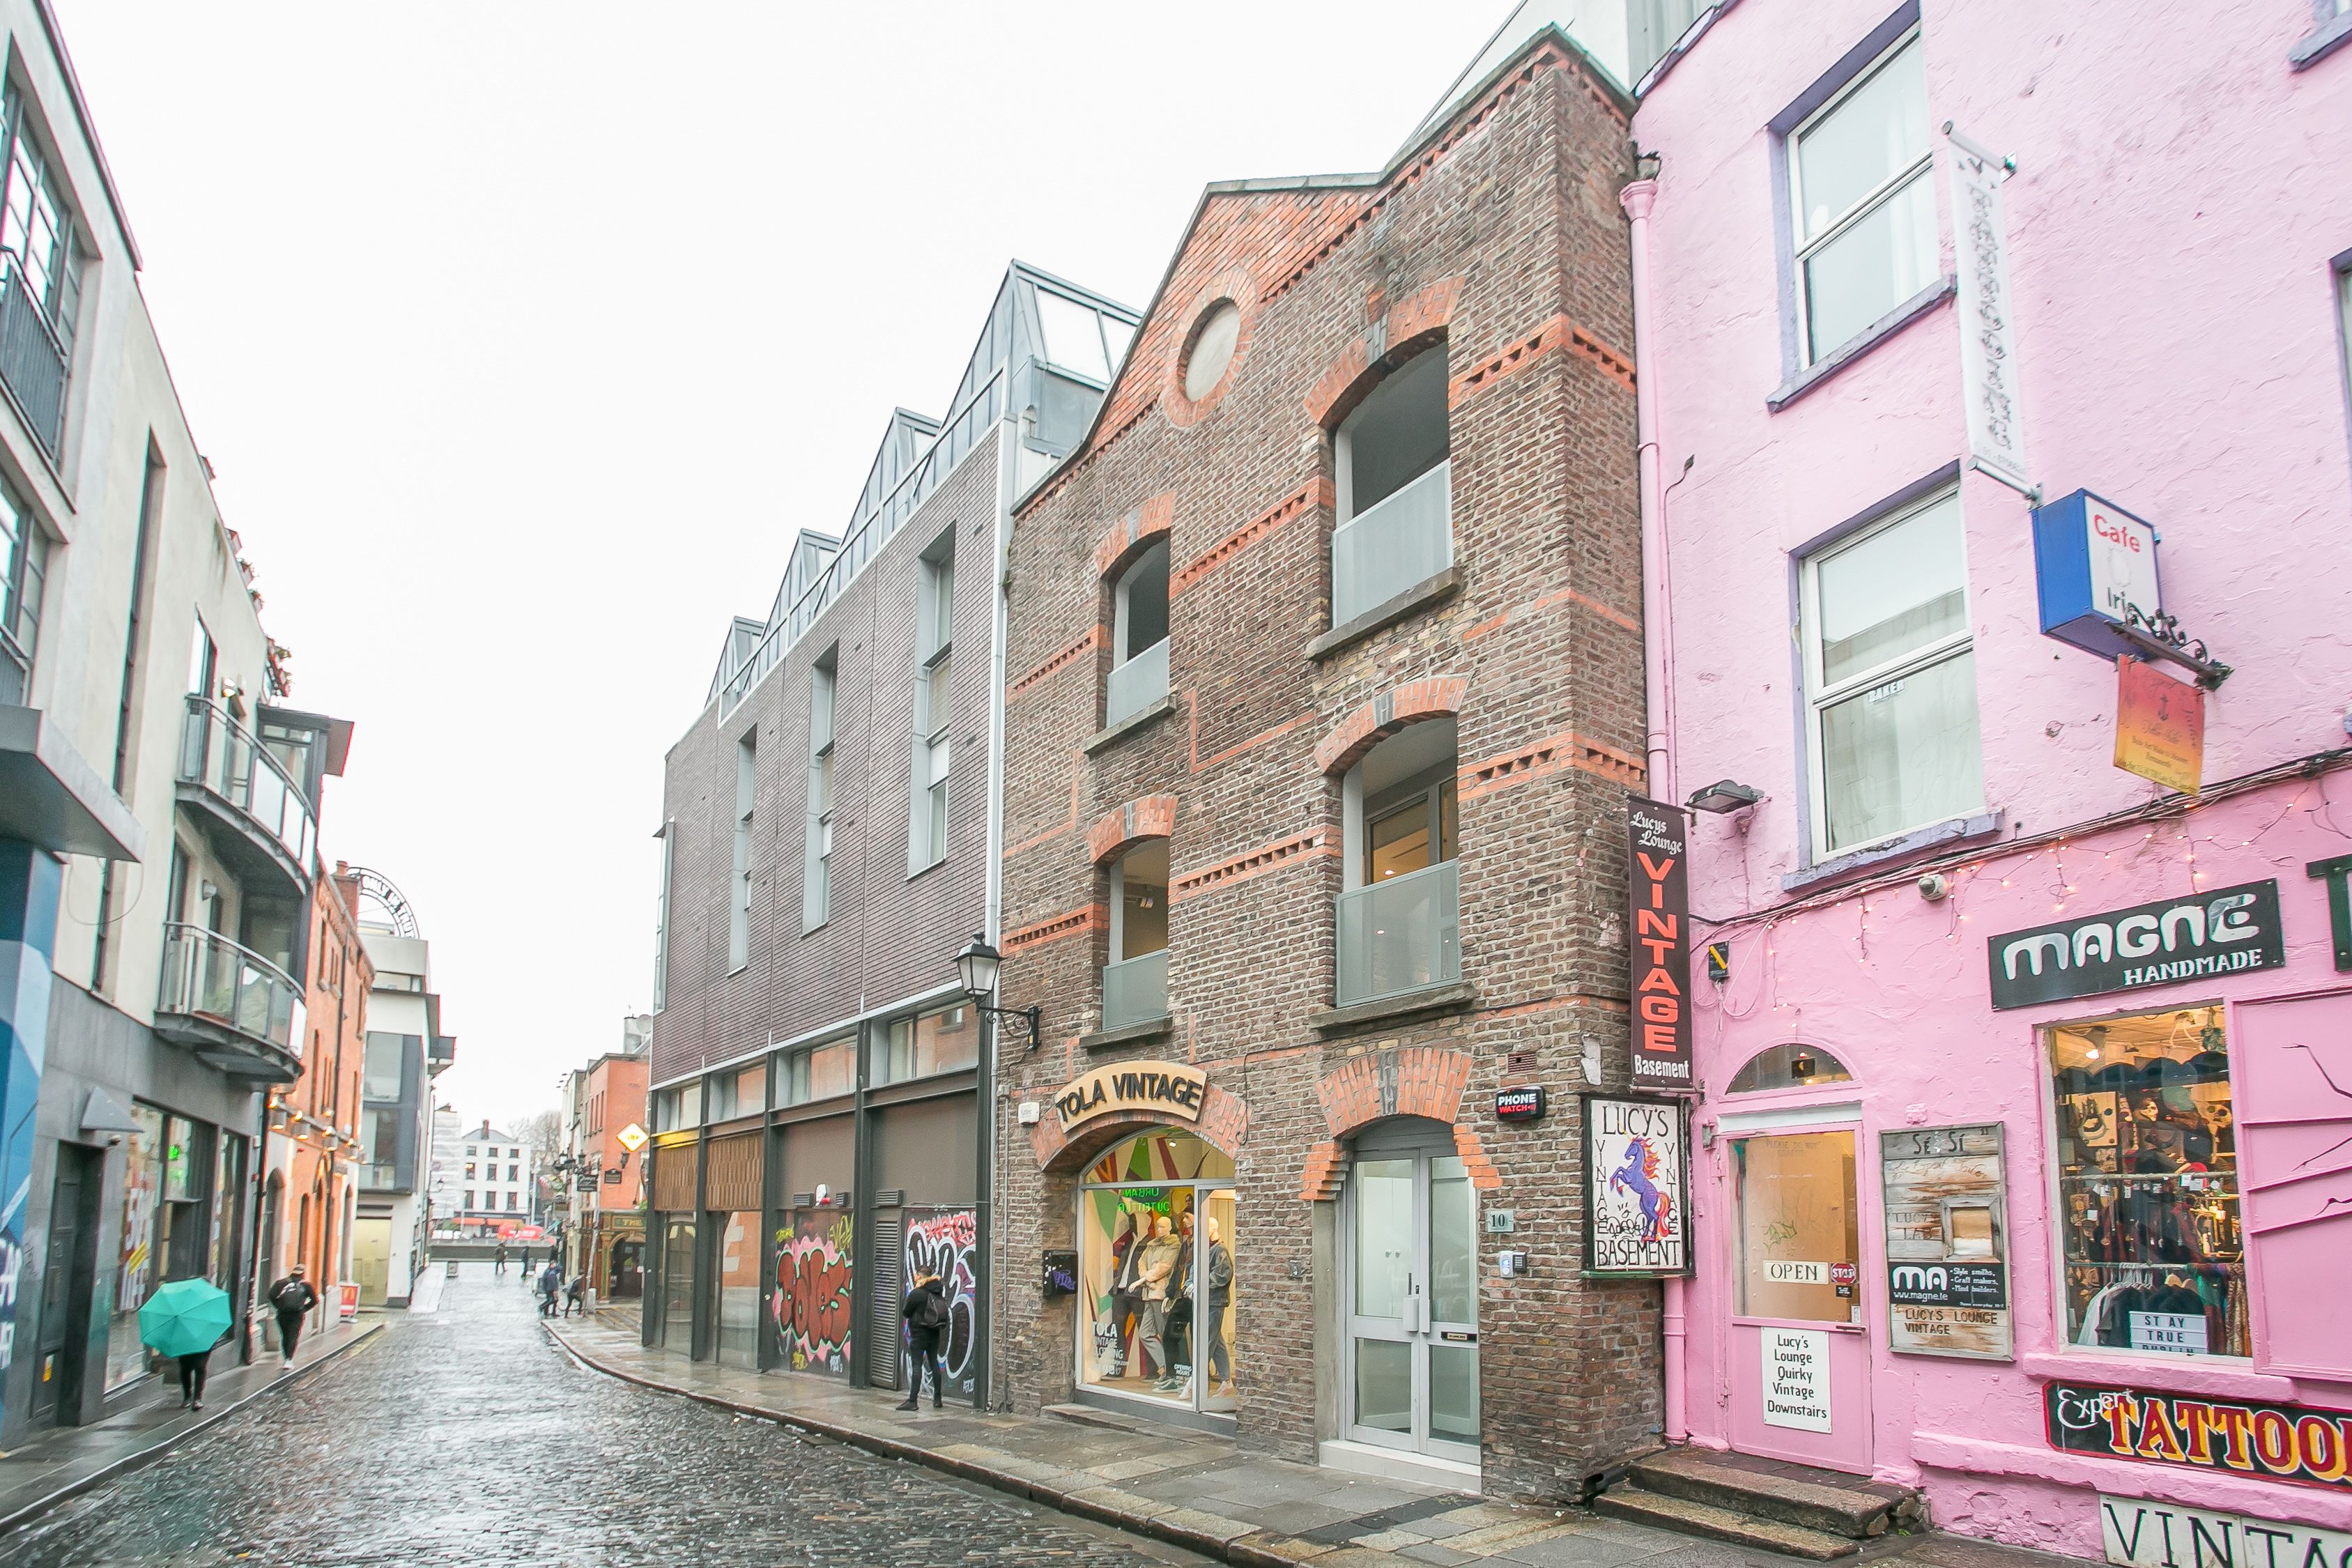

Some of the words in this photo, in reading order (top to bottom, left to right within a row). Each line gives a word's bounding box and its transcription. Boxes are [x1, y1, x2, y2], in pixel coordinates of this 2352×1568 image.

[2093, 514, 2141, 553] Cafe
[2106, 586, 2134, 616] Iri
[1629, 810, 1668, 835] Lucys
[1637, 829, 1684, 855] Lounge
[2002, 893, 2260, 981] MAGNE
[1636, 851, 1681, 1053] VINTAGE
[2123, 948, 2263, 985] HANDMADE
[1634, 1054, 1689, 1079] Basement
[1055, 1078, 1107, 1123] TOLA
[1112, 1072, 1204, 1112] VINTAGE
[1498, 1093, 1537, 1106] PHONE
[1498, 1104, 1528, 1114] WATCH
[1602, 1105, 1668, 1137] LUCY'S
[1595, 1138, 1608, 1234] VINTAGE
[1664, 1142, 1680, 1236] VINTAGE
[1491, 1214, 1506, 1228] 10
[1596, 1238, 1680, 1266] BASEMENT
[1771, 1263, 1818, 1281] OPEN
[1092, 1321, 1118, 1337] TOLA
[1905, 1322, 1951, 1335] VINTAGE
[1954, 1311, 1998, 1325] LOUNGE
[1777, 1334, 1809, 1351] Lucy's
[2147, 1330, 2184, 1343] TRUE
[1774, 1348, 1813, 1366] Lounge
[1778, 1366, 1813, 1384] Quirky
[1772, 1381, 1815, 1400] Vintage
[1767, 1399, 1827, 1419] Downstairs
[2058, 1388, 2134, 1429] Expert
[2103, 1502, 2352, 1568] VINTA
